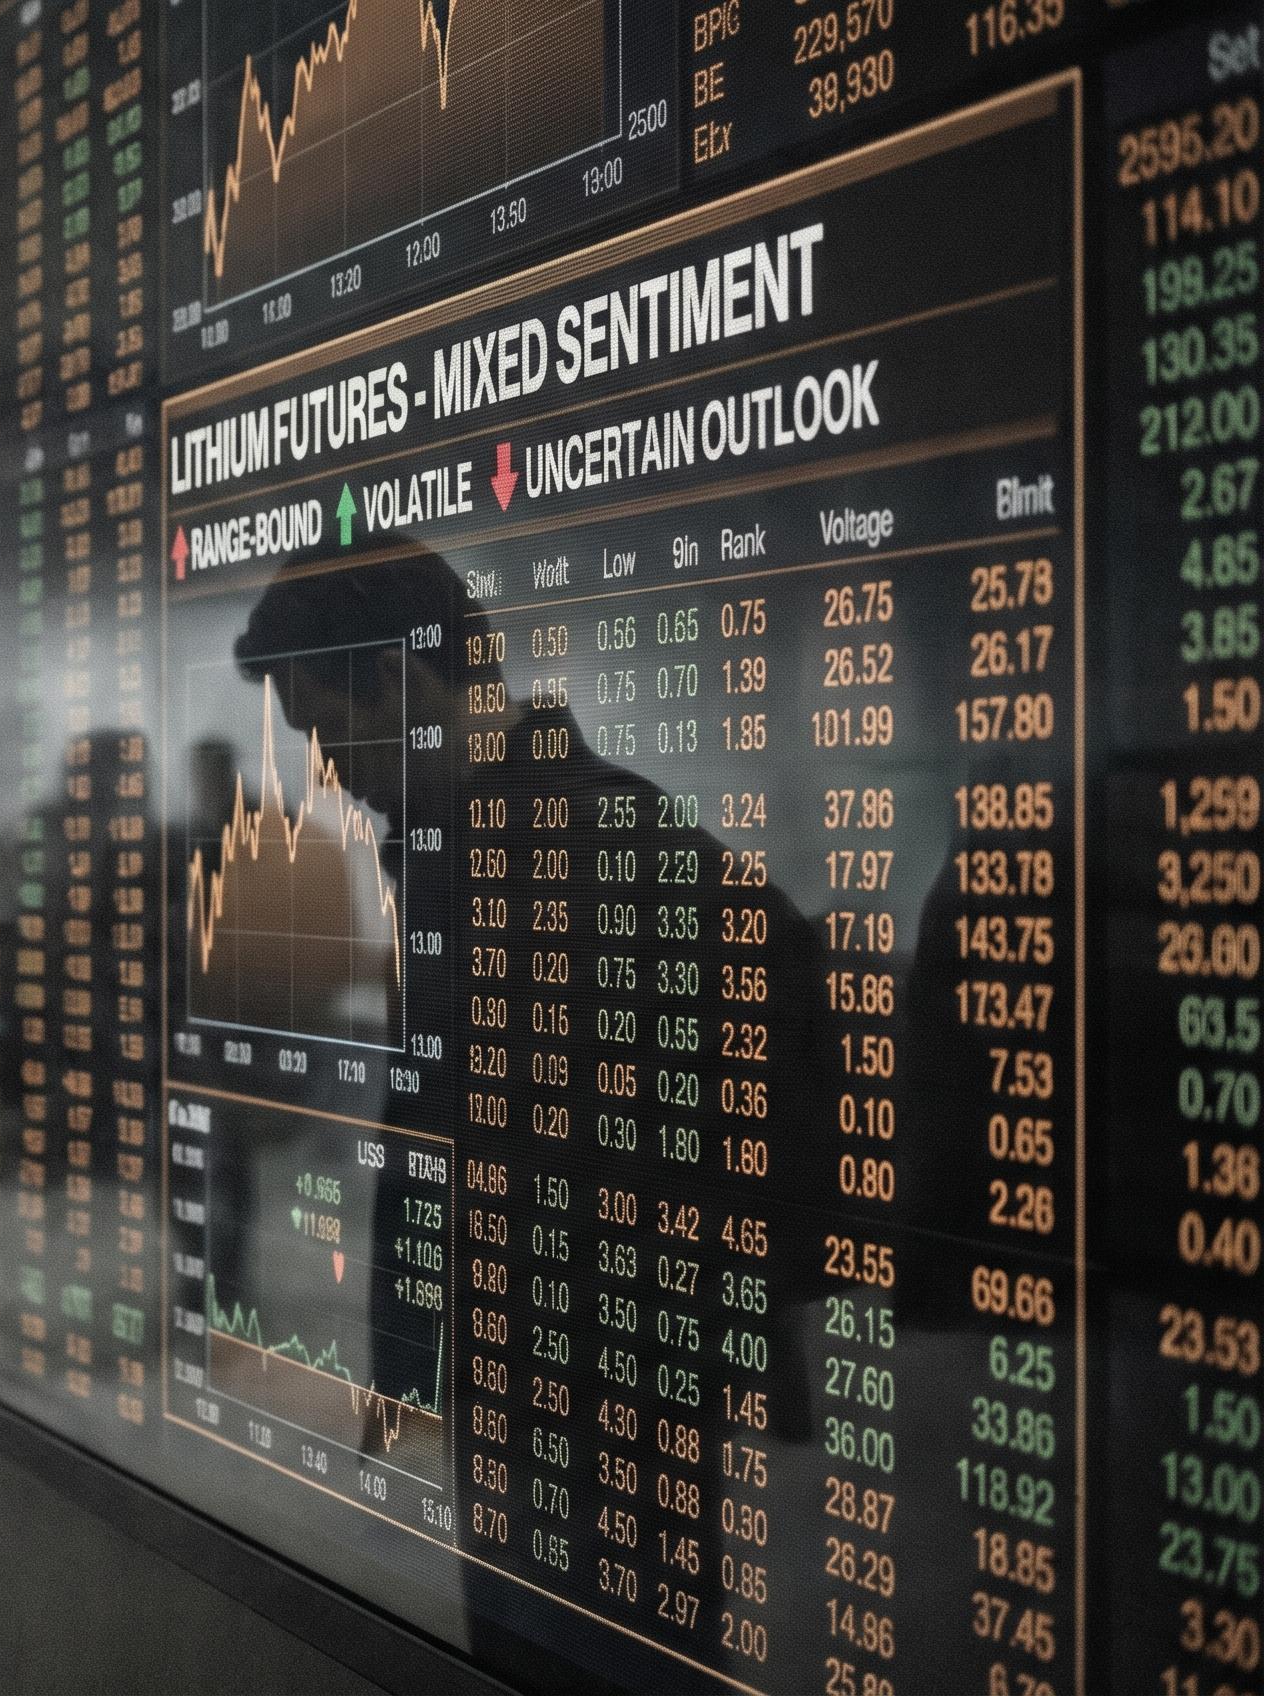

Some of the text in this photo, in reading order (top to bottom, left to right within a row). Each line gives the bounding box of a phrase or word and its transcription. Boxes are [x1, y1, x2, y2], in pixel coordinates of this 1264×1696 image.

[627, 98, 668, 141] 2500
[694, 62, 726, 108] BE
[1140, 168, 1262, 246] 114.10
[171, 406, 270, 495] LITHIUM
[274, 360, 408, 461] FUTURES
[434, 316, 548, 420] MIXED
[555, 222, 824, 385] SENTIMENT
[1137, 383, 1262, 458] 212.00
[190, 359, 881, 571] RANGE-BOUND VOLATILE UNCERTAIN OUTLOOK
[603, 549, 636, 579] Low
[721, 523, 766, 562] Rank
[819, 506, 894, 548] Voltage
[531, 624, 569, 659] 0.50
[656, 606, 699, 645] 0.65
[720, 597, 767, 639] 0.75
[823, 580, 894, 628] 26.75
[595, 623, 1054, 706] 0.75 0.70 1.39 26.52 26.17
[531, 727, 569, 761] 0.00
[596, 723, 637, 757] 0.75
[656, 718, 698, 755] 0.13
[722, 713, 767, 751] 1.85
[954, 691, 1055, 744] 157.80
[1181, 675, 1263, 733] 1.50
[532, 796, 569, 830] 2.00
[597, 794, 637, 829] 2.55
[656, 794, 700, 829] 2.00
[720, 792, 767, 829] 3.24
[532, 848, 570, 881] 2.00
[596, 849, 637, 883] 0.10
[721, 849, 768, 888] 2.25
[825, 849, 894, 891] 17.97
[597, 902, 637, 938] 0.90
[656, 904, 700, 941] 3.35
[721, 907, 768, 945] 3.20
[825, 911, 895, 954] 17.19
[954, 915, 1055, 966] 143.75
[471, 945, 1055, 1032] 3.70 0.20 0.75 3.30 3.56 15.86 173.47
[597, 1007, 1055, 1100] 0.20 0.55 2.32 1.50 7.53
[597, 1061, 638, 1098] 0.05
[657, 1069, 700, 1108] 0.20
[720, 1077, 768, 1119] 0.36
[839, 1093, 895, 1140] 0.10
[987, 1112, 1055, 1167] 0.65
[1176, 1065, 1263, 1128] 0.70
[532, 1103, 570, 1140] 0.20
[597, 1113, 638, 1152] 0.30
[658, 1124, 700, 1164] 1.80
[722, 1136, 768, 1178] 1.80
[839, 1154, 895, 1202] 0.80
[403, 1197, 442, 1230] 1.725
[533, 1173, 570, 1211] 1.50
[597, 1186, 638, 1227] 3.00
[657, 1200, 701, 1242] 3.42
[720, 1215, 769, 1258] 4.65
[824, 1234, 896, 1289] 23.55
[970, 1264, 1056, 1326] 69.66
[1176, 1208, 1263, 1275] 0.40
[598, 1239, 638, 1279] 3.63
[657, 1254, 700, 1296] 0.27
[721, 1270, 768, 1315] 3.65
[824, 1296, 896, 1350] 26.15
[988, 1335, 1057, 1393] 6.25
[1158, 1302, 1262, 1377] 23.53
[598, 1292, 638, 1334] 3.50
[656, 1309, 701, 1353] 0.75
[720, 1328, 769, 1373] 4.00
[824, 1356, 895, 1412] 27.60
[970, 1394, 1057, 1461] 33.86
[531, 1324, 570, 1366] 2.50
[597, 1346, 638, 1388] 4.50
[656, 1363, 701, 1408] 0.25
[722, 1384, 768, 1431] 1.45
[824, 1416, 895, 1473] 36.00
[955, 1456, 1056, 1526] 118.92
[1182, 1383, 1263, 1450] 1.50
[531, 1375, 571, 1417] 2.50
[597, 1398, 638, 1442] 4.30
[657, 1418, 701, 1464] 0.88
[824, 1475, 896, 1534] 28.87
[973, 1527, 1056, 1595] 18.85
[598, 1450, 638, 1496] 3.50
[656, 1472, 701, 1520] 0.88
[721, 1497, 768, 1547] 0.30
[824, 1535, 896, 1598] 26.29
[1160, 1449, 1263, 1524] 13.00
[531, 1477, 570, 1520] 0.70
[596, 1505, 638, 1549] 4.50
[658, 1530, 701, 1576] 1.45
[721, 1553, 768, 1605] 0.85
[1156, 1519, 1262, 1597] 23.75
[472, 1501, 508, 1544] 8.70
[598, 1557, 638, 1604] 3.70
[657, 1582, 700, 1629] 2.97
[720, 1610, 768, 1663] 2.00
